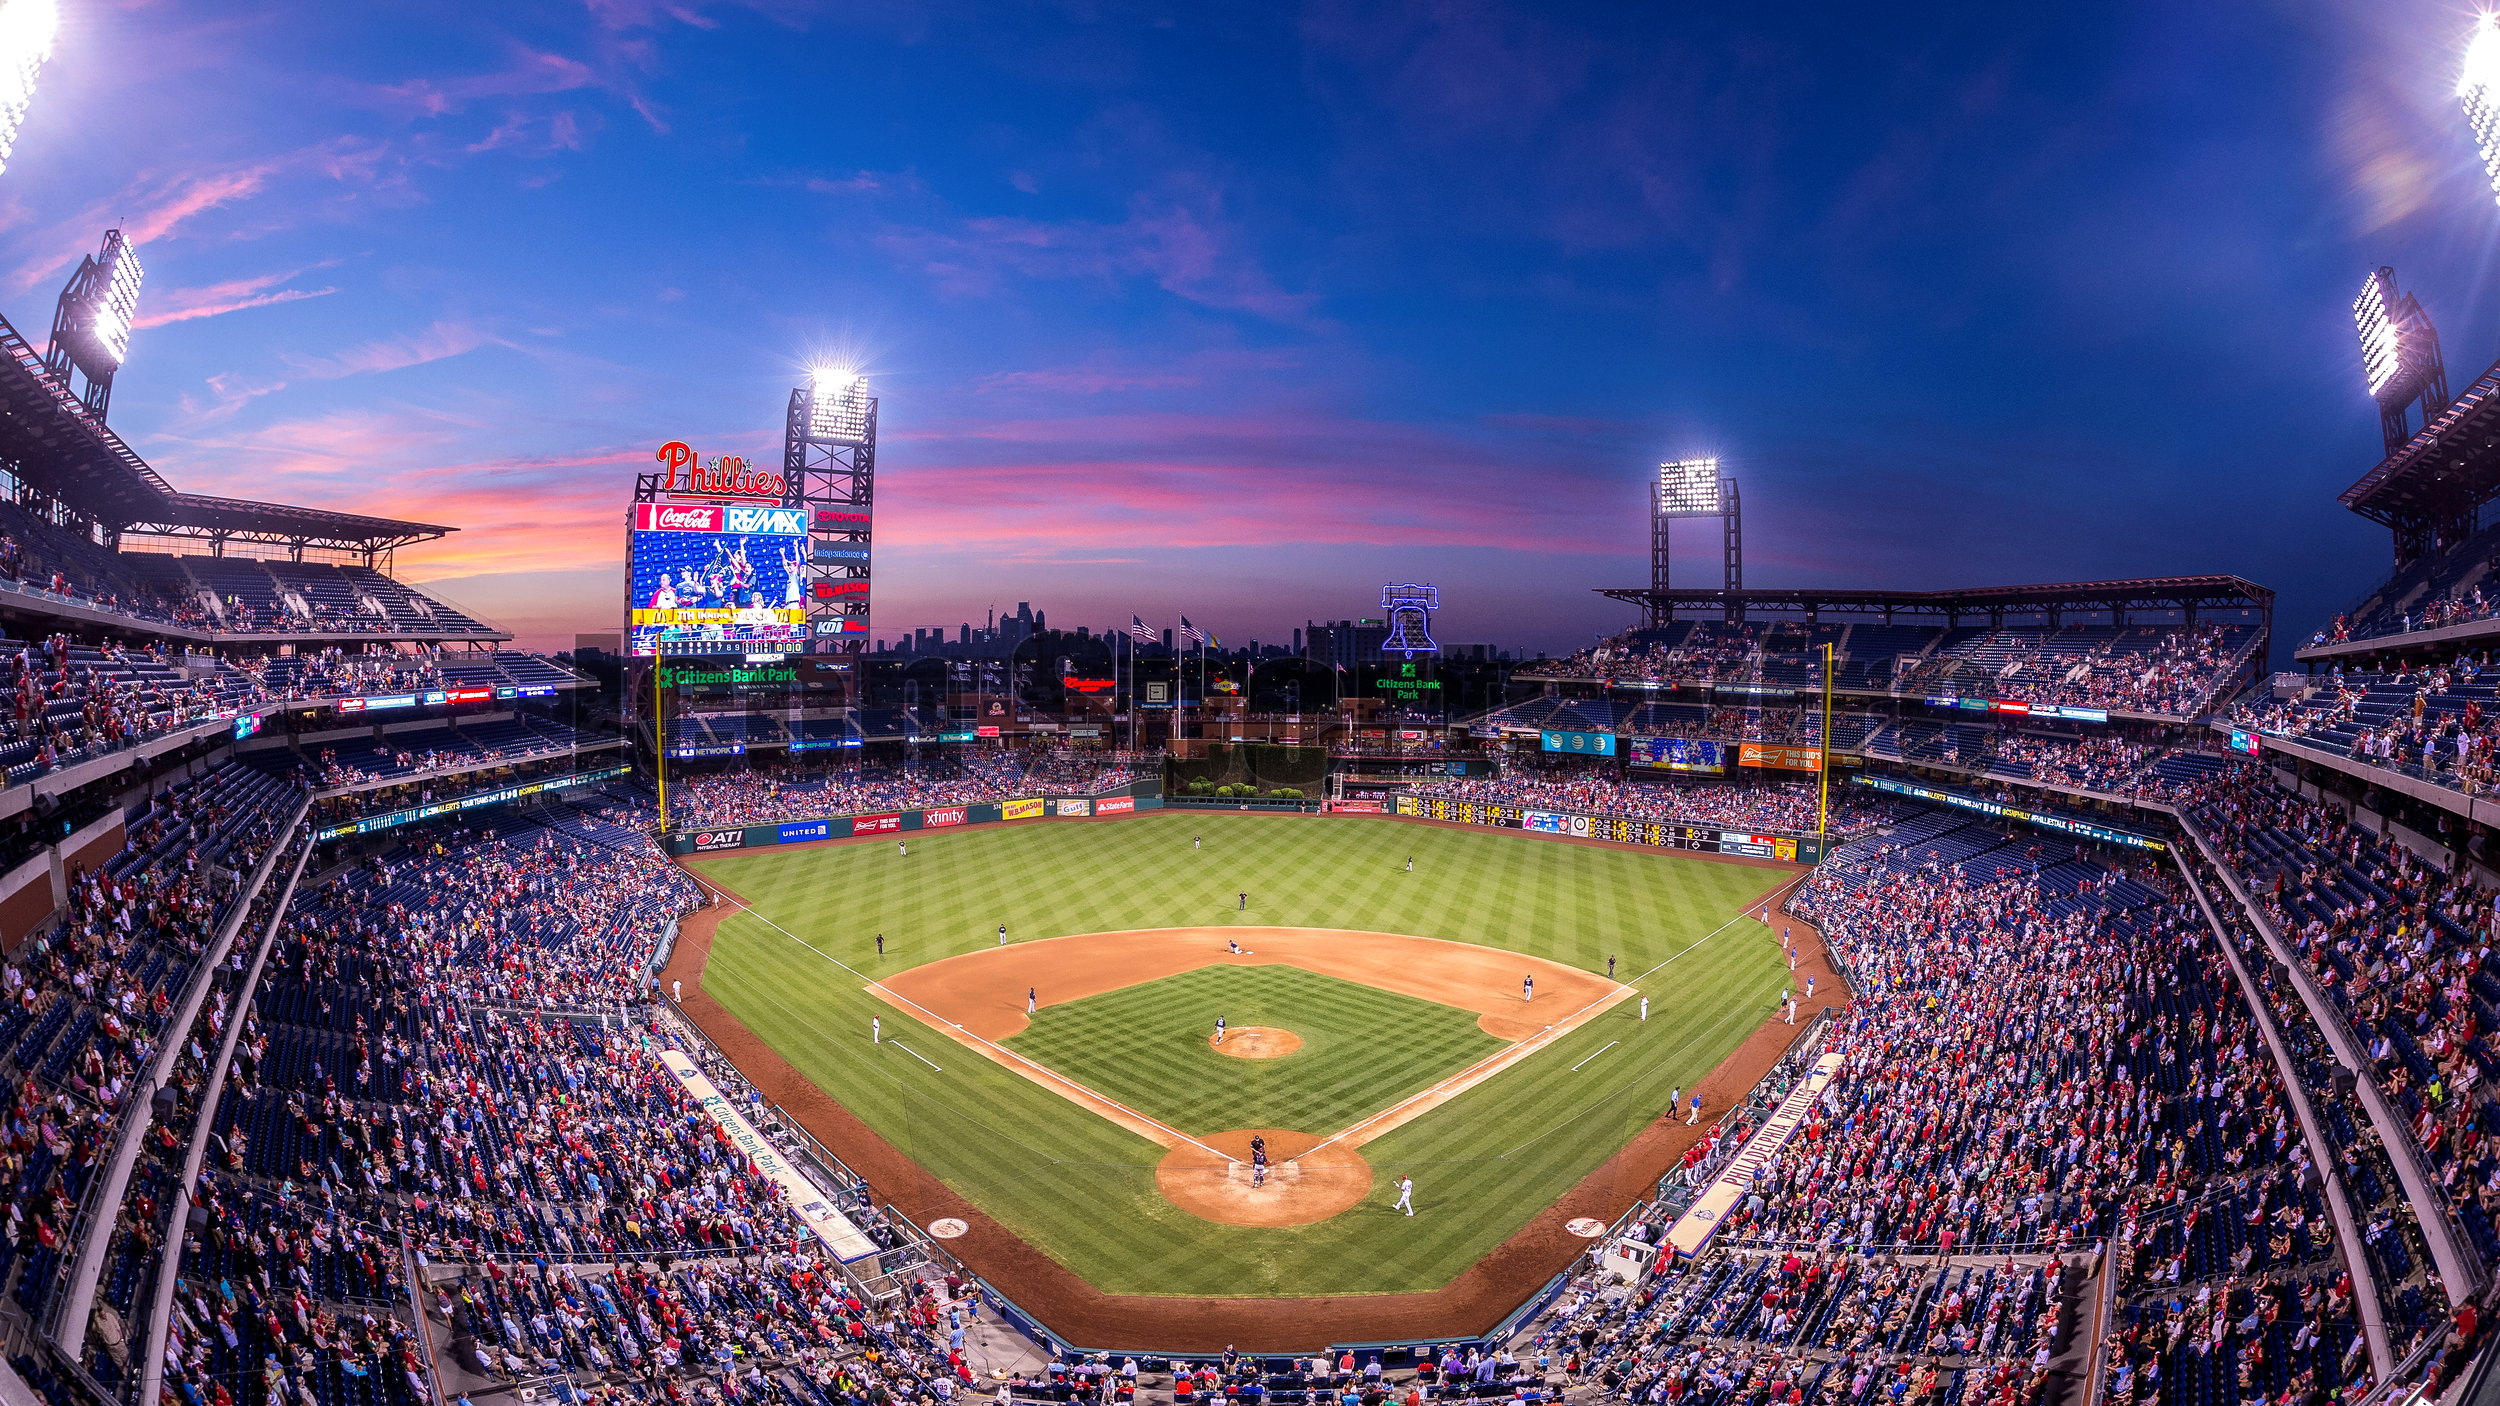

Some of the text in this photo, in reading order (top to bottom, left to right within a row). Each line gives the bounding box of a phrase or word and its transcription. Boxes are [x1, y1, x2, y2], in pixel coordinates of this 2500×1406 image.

[657, 440, 787, 499] Phillies
[659, 507, 715, 529] Coca-Cola
[729, 507, 804, 533] RE/MAX
[830, 511, 870, 523] TOYOTA
[675, 666, 798, 685] Citizens Bank Park
[1376, 679, 1440, 690] Citizens Bank
[1397, 690, 1419, 699] Park
[679, 747, 732, 757] MLB NETWORK
[1785, 749, 1822, 760] THIS BUD'S
[1785, 758, 1815, 768] FOR YOU.
[1063, 804, 1083, 814] Gulf
[712, 830, 743, 844] ATI
[782, 828, 817, 838] UNITED
[696, 842, 741, 851] PHYSICAL THERAPY
[713, 1105, 783, 1176] Citizens Bank Park
[1721, 1087, 1818, 1187] PHILADELPHIA PHILLIES
